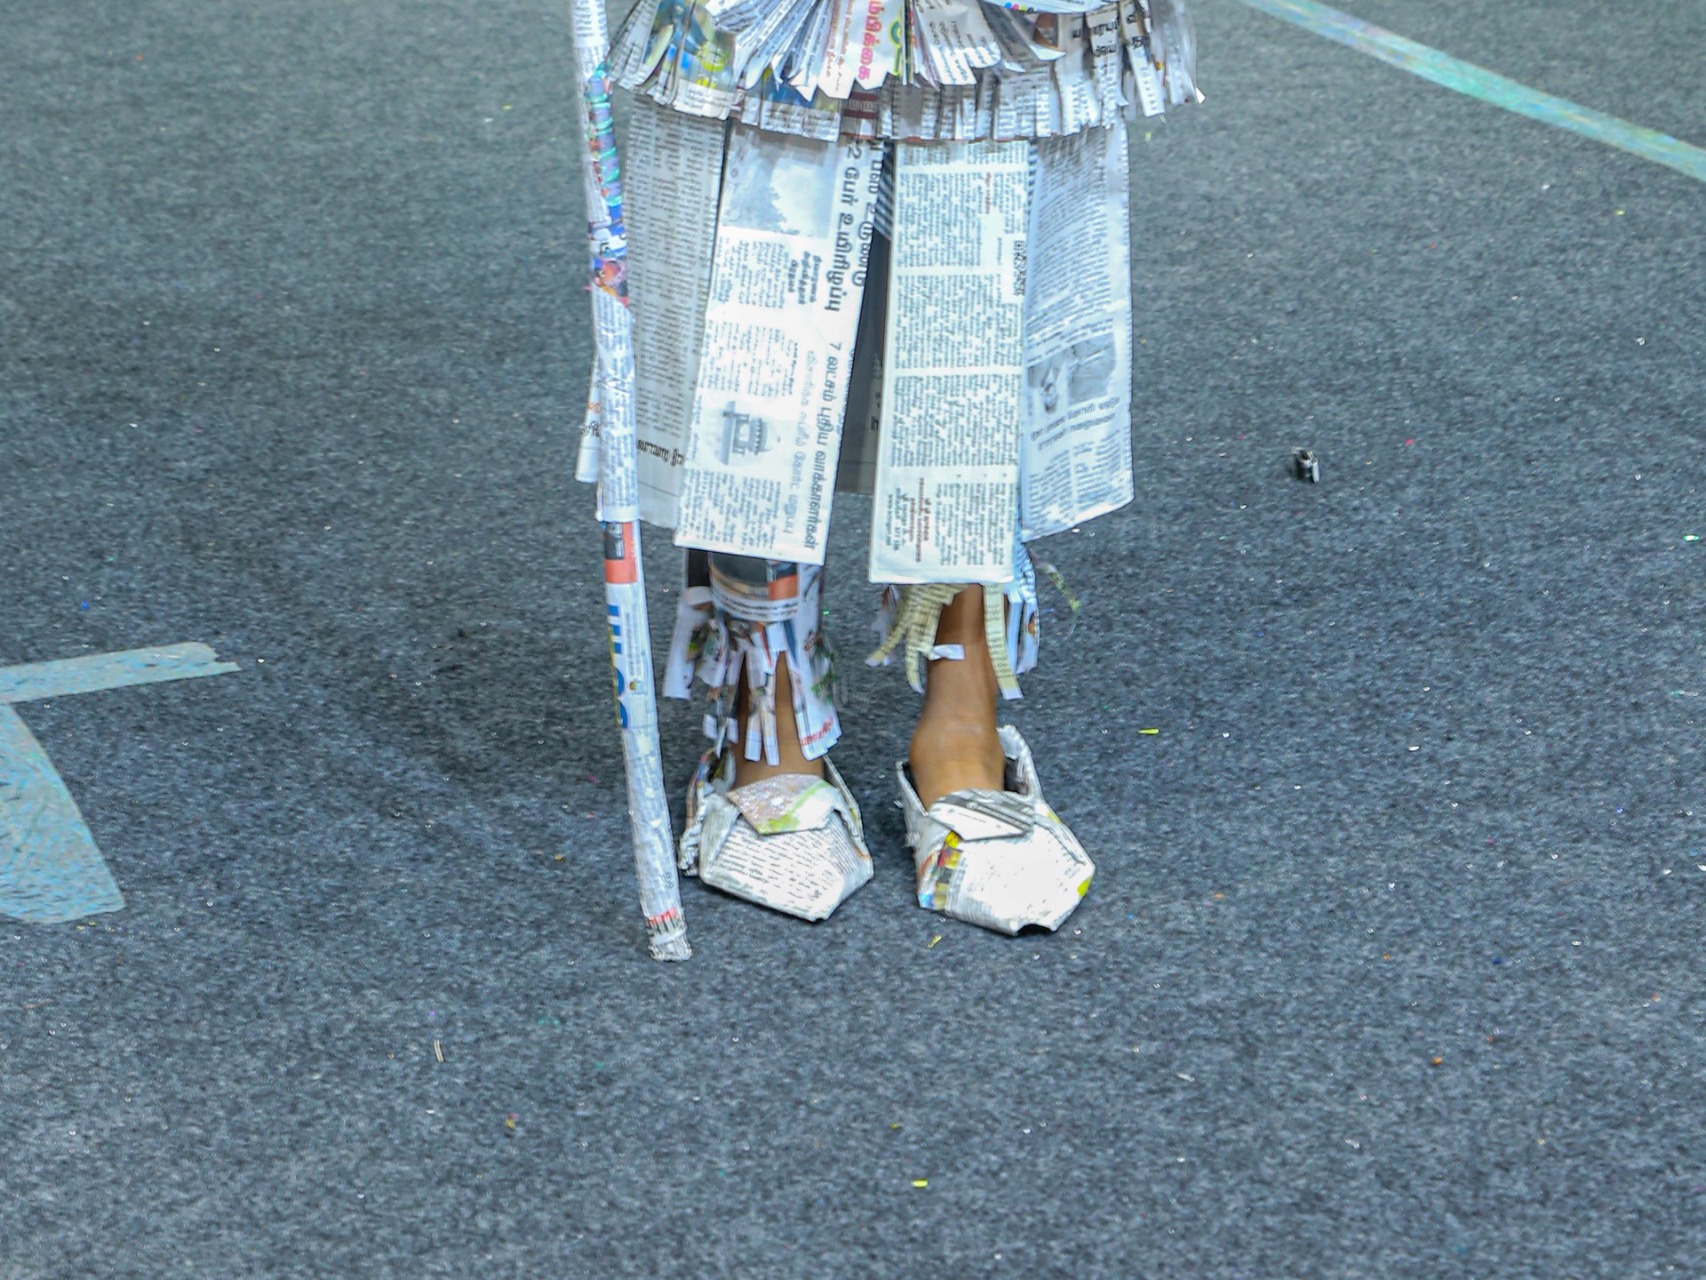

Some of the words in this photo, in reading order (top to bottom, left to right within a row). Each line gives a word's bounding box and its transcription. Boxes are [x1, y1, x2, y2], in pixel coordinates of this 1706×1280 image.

[840, 166, 861, 205] பேர்
[824, 213, 855, 311] உயிரிழப்பு
[821, 355, 841, 402] லட்சம்
[812, 406, 836, 446] புதிய
[802, 450, 830, 550] வாக்காளர்கள்
